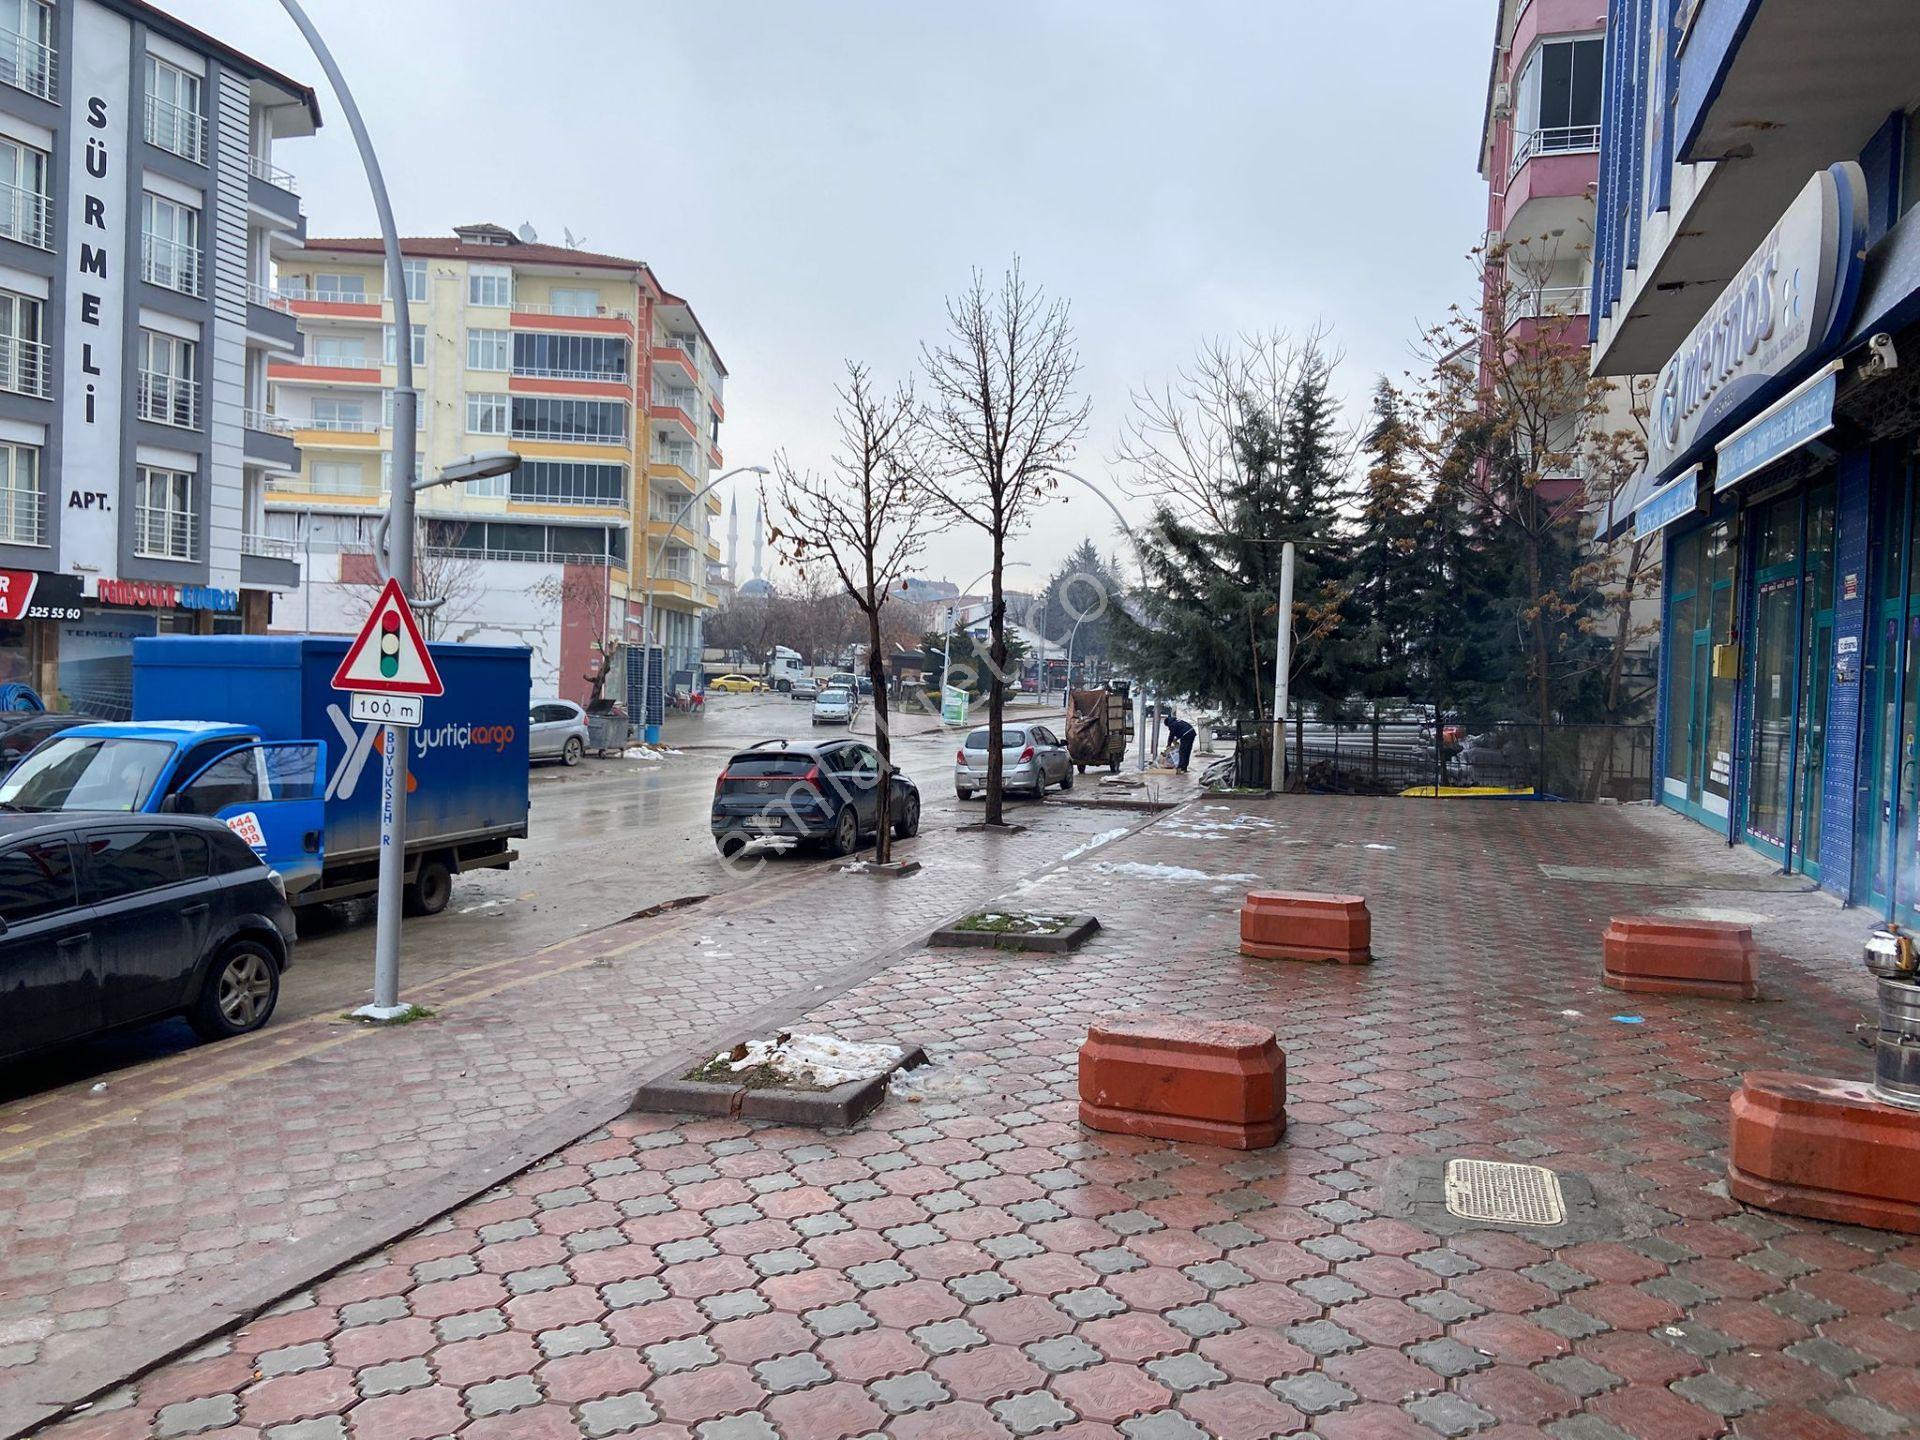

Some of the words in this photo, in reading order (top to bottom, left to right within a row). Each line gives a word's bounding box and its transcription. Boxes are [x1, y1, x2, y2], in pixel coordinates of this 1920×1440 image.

[79, 96, 109, 425] SÜRMELİ
[1681, 250, 1779, 420] merinos
[68, 490, 111, 512] APT.
[29, 607, 49, 617] 325
[51, 608, 64, 618] 55
[66, 608, 81, 619] 60
[360, 699, 391, 718] 100
[400, 706, 414, 718] m
[229, 815, 252, 829] 444
[240, 825, 256, 837] 99
